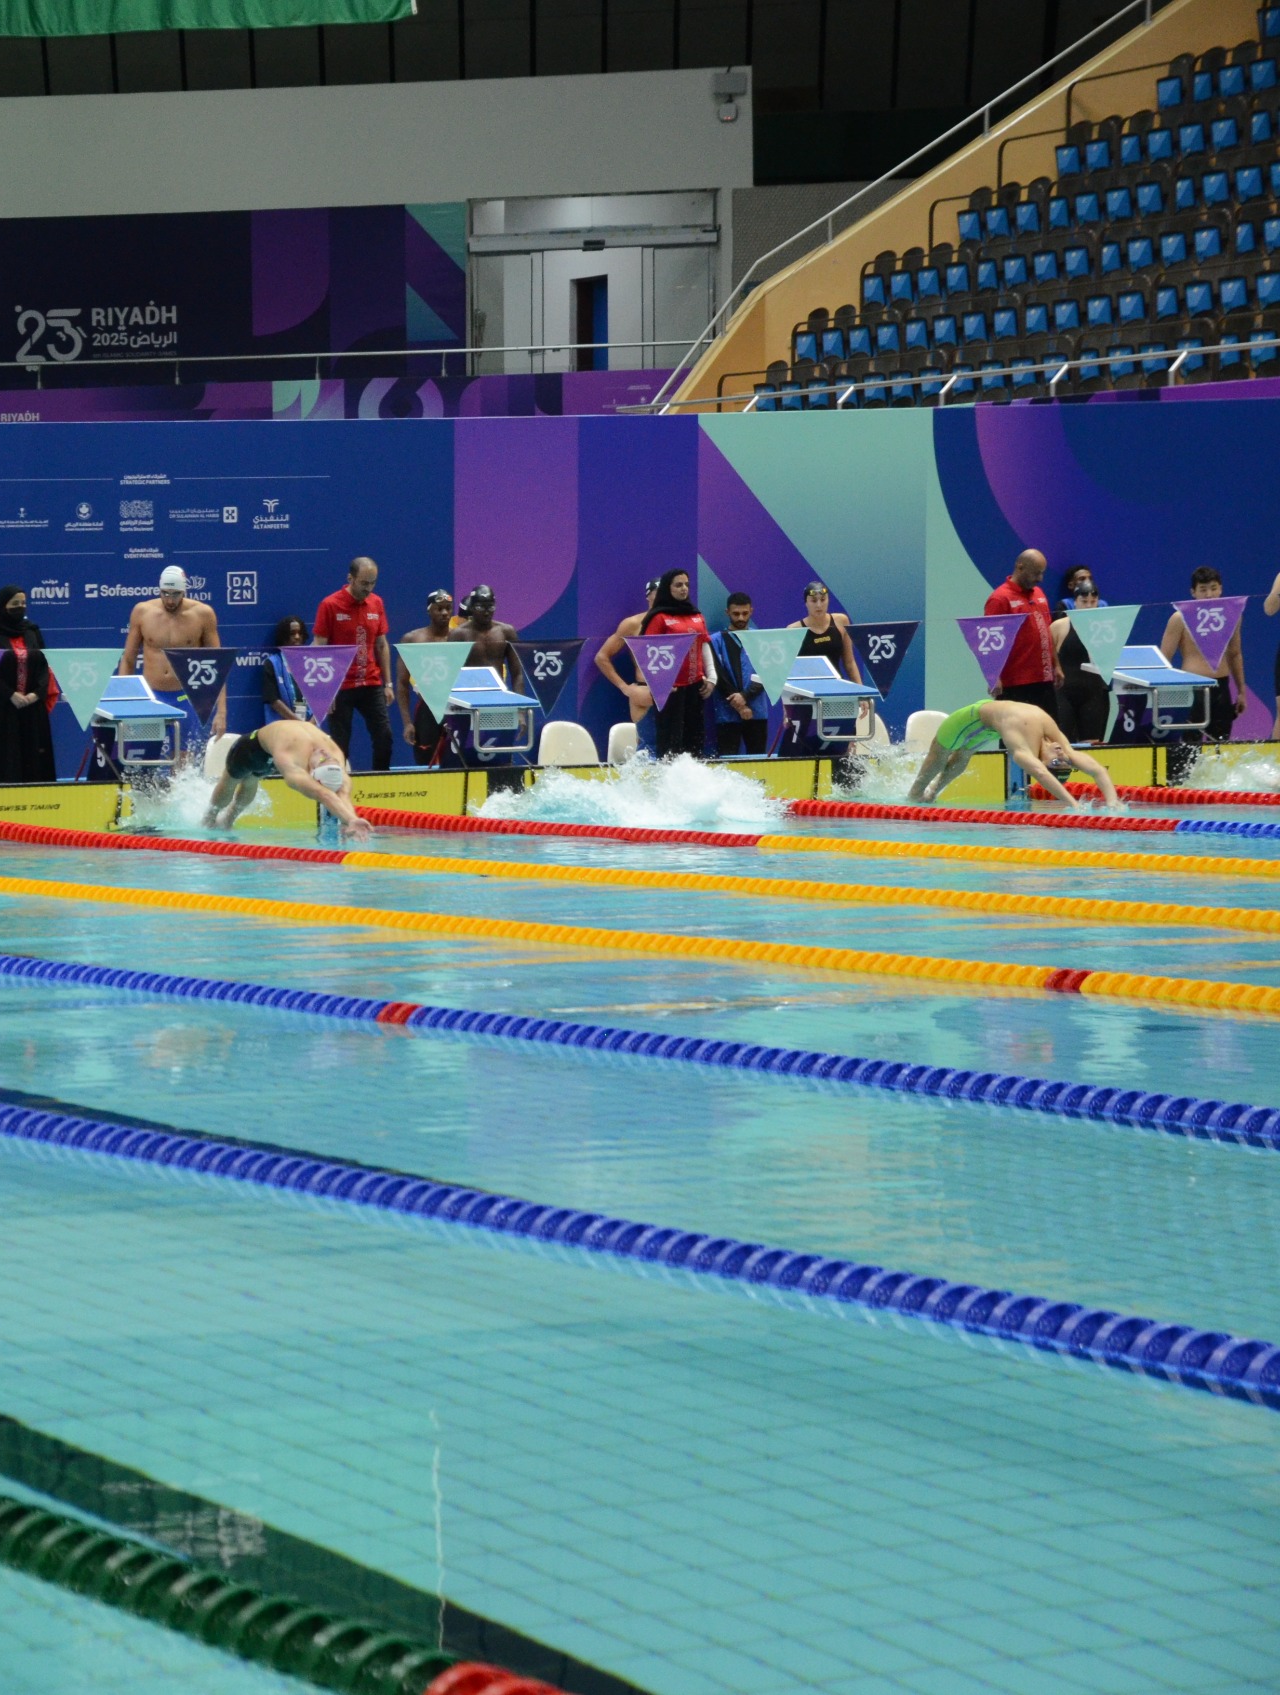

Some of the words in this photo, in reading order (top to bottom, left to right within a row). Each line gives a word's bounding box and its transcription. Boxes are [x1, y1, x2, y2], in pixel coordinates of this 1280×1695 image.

[91, 301, 177, 329] RIYADH
[15, 305, 87, 371] 25
[92, 332, 128, 346] 2025
[130, 331, 178, 348] الرياض
[1, 411, 40, 422] RIYADH
[31, 582, 69, 599] muvi
[100, 584, 161, 597] Sofascore
[1196, 606, 1227, 636] 25
[868, 633, 897, 663] 25
[977, 625, 1006, 655] 25
[303, 655, 335, 686] 25
[534, 650, 563, 680] 25
[647, 644, 676, 674] 25
[187, 658, 219, 689] 25
[791, 719, 801, 743] 7
[1123, 709, 1135, 732] 8
[30, 802, 61, 811] TIMING
[367, 791, 396, 800] SWISS
[398, 790, 430, 798] TIMING
